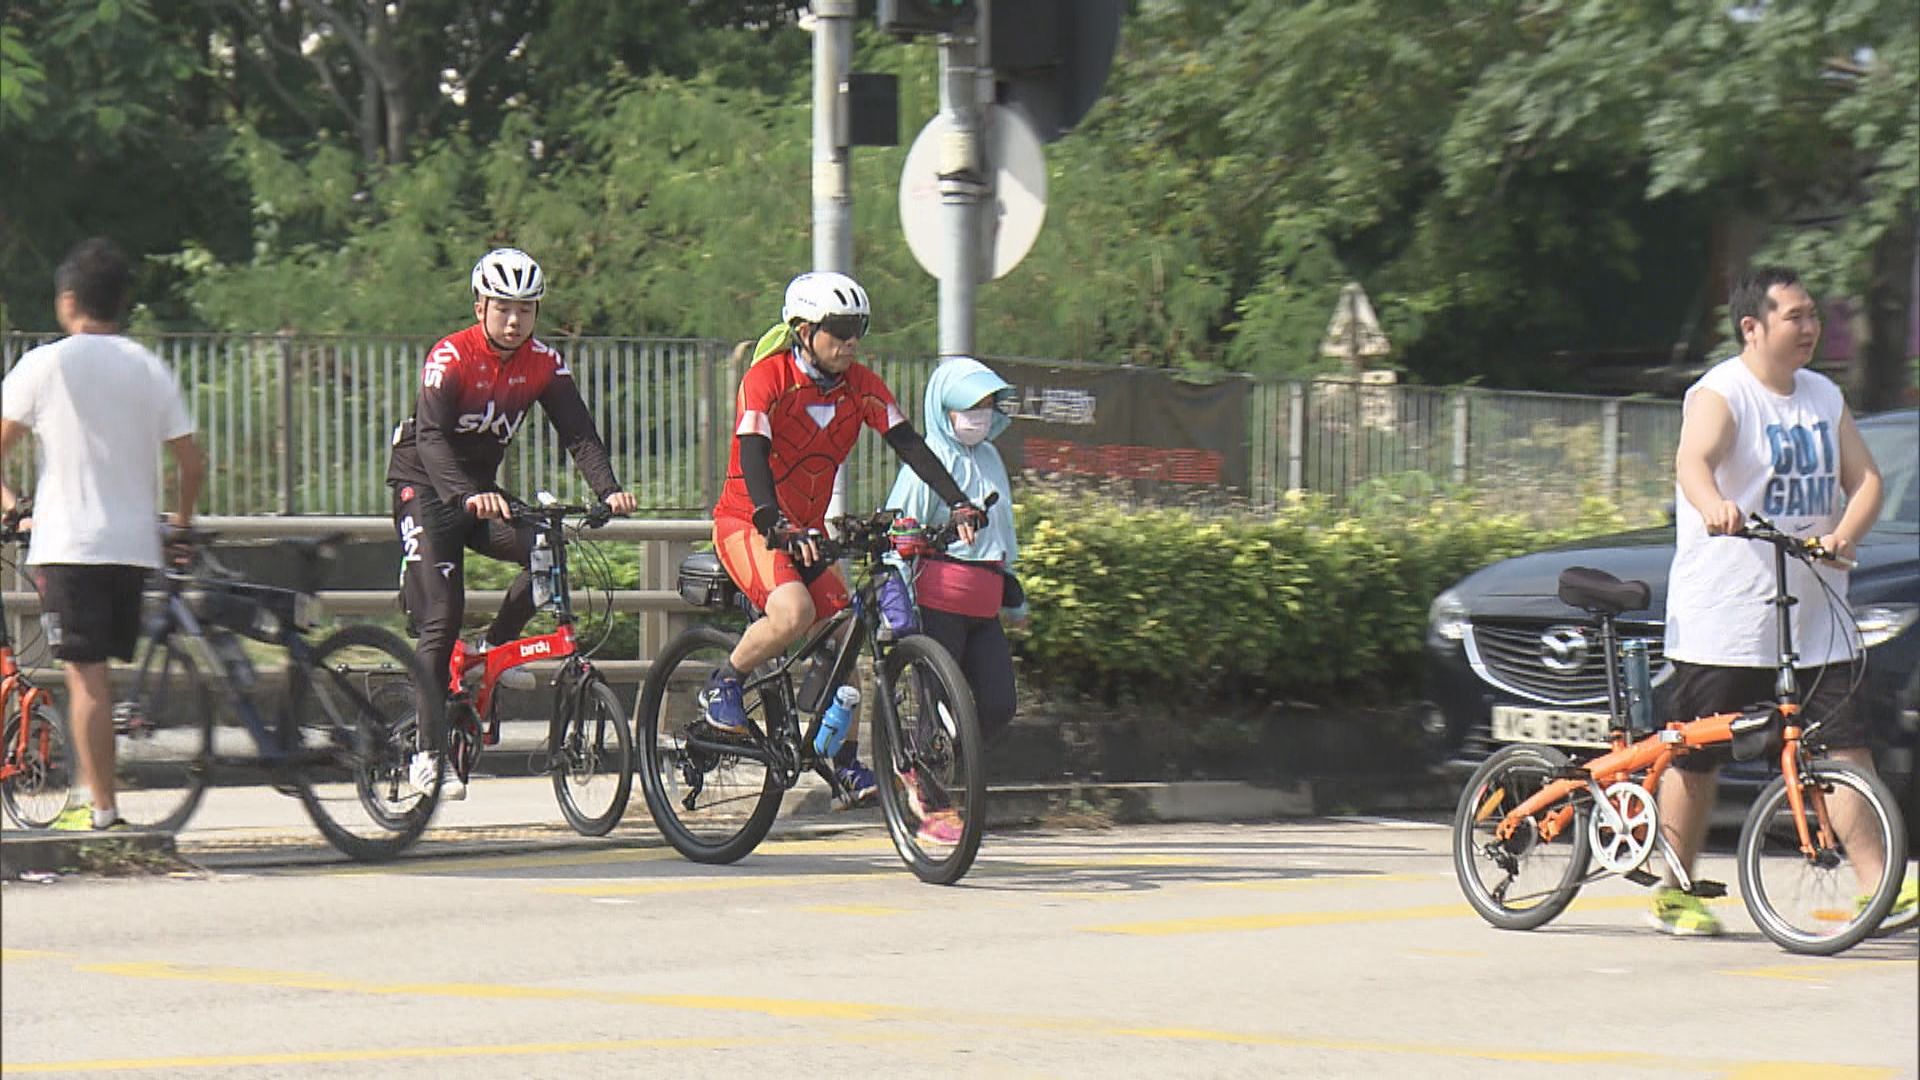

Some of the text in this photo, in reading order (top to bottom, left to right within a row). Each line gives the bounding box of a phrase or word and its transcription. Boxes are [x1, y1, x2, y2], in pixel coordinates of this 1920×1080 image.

[455, 400, 529, 444] sky
[1766, 421, 1834, 475] GOT
[520, 640, 551, 657] birdy
